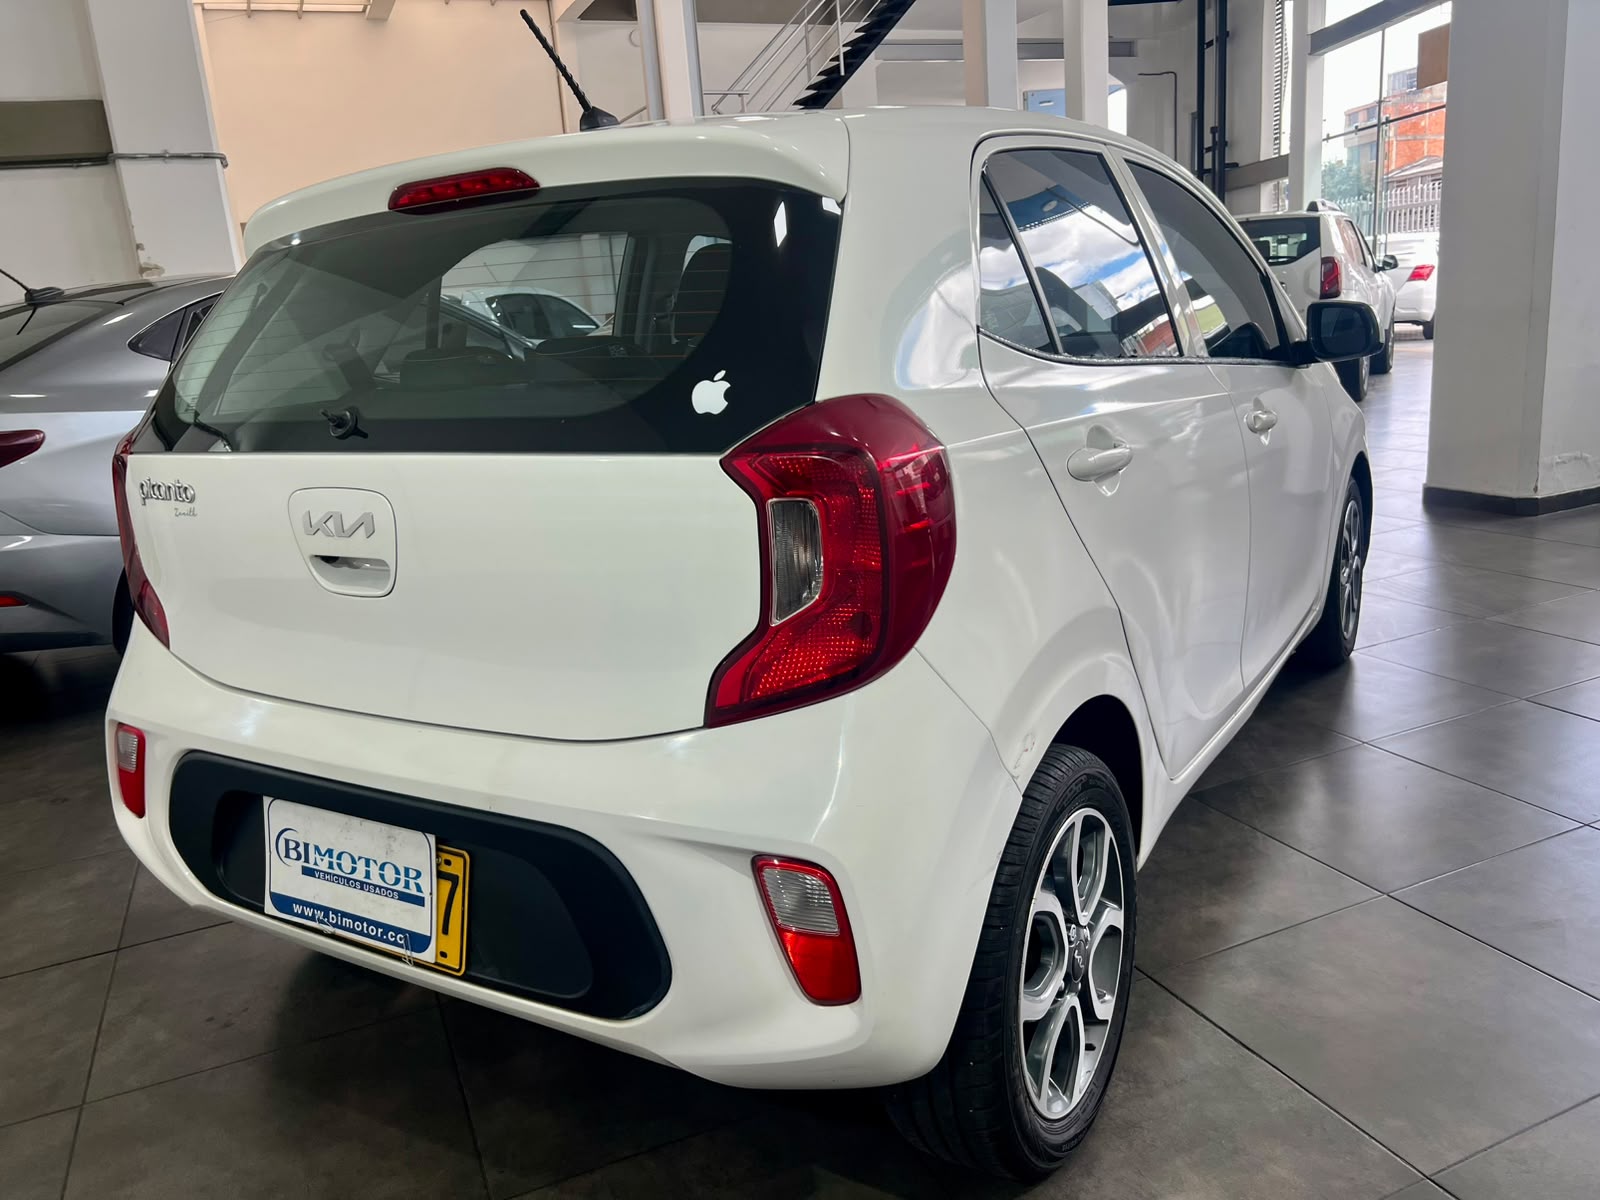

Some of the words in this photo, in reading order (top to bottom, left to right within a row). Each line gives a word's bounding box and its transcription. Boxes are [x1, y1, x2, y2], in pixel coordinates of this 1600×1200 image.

[139, 477, 196, 506] picanto
[303, 510, 376, 539] KIA
[283, 837, 425, 894] BIMOTOR
[363, 883, 399, 900] USADOS
